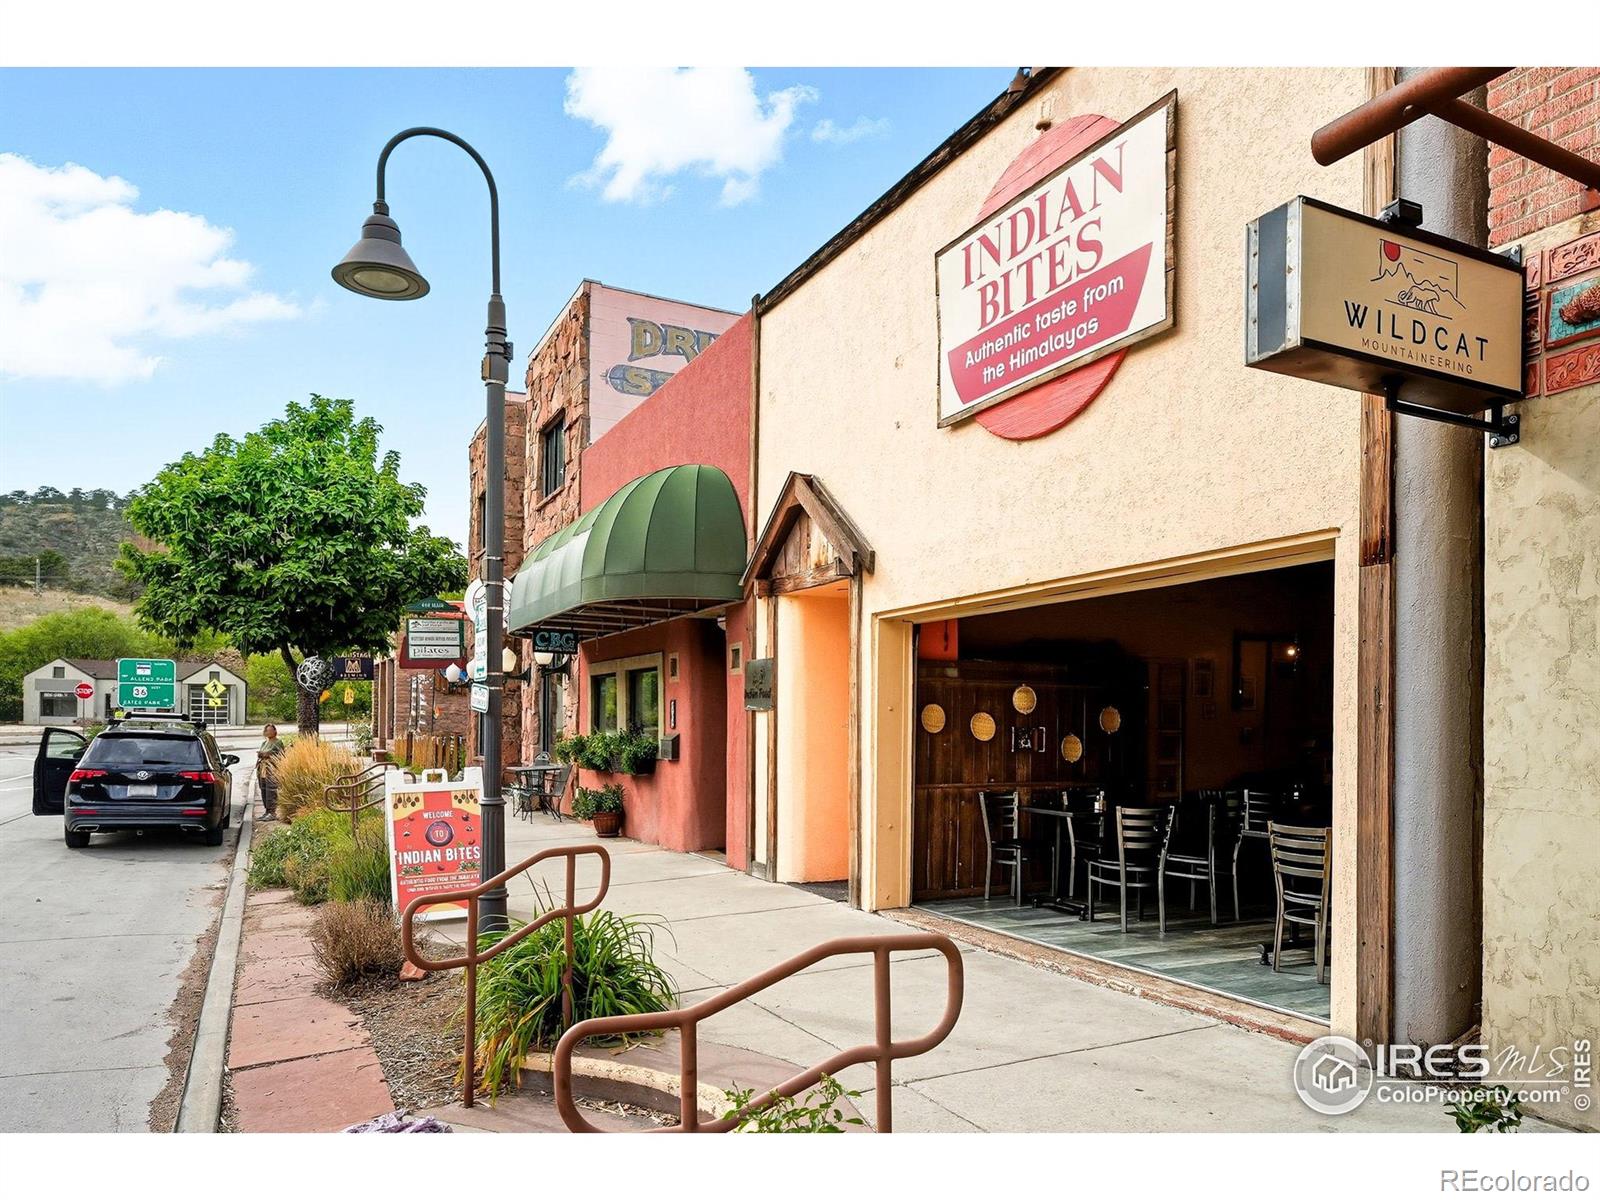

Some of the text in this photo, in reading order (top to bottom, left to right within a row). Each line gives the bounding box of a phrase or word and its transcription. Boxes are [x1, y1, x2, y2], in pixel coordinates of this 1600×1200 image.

[961, 140, 1128, 290] INDIAN
[976, 216, 1105, 332] BITES
[965, 275, 1124, 368] Authentic taste from
[1344, 300, 1489, 361] WILDCAT
[983, 316, 1099, 384] the Himalayas
[1361, 338, 1473, 375] MOUNTAINEERING
[536, 631, 576, 648] CBG
[413, 646, 450, 657] pilates
[76, 687, 93, 695] STOP
[134, 688, 147, 696] 36
[423, 810, 454, 819] WELCOME
[435, 829, 444, 838] TO
[399, 846, 481, 865] INDIAN BITES
